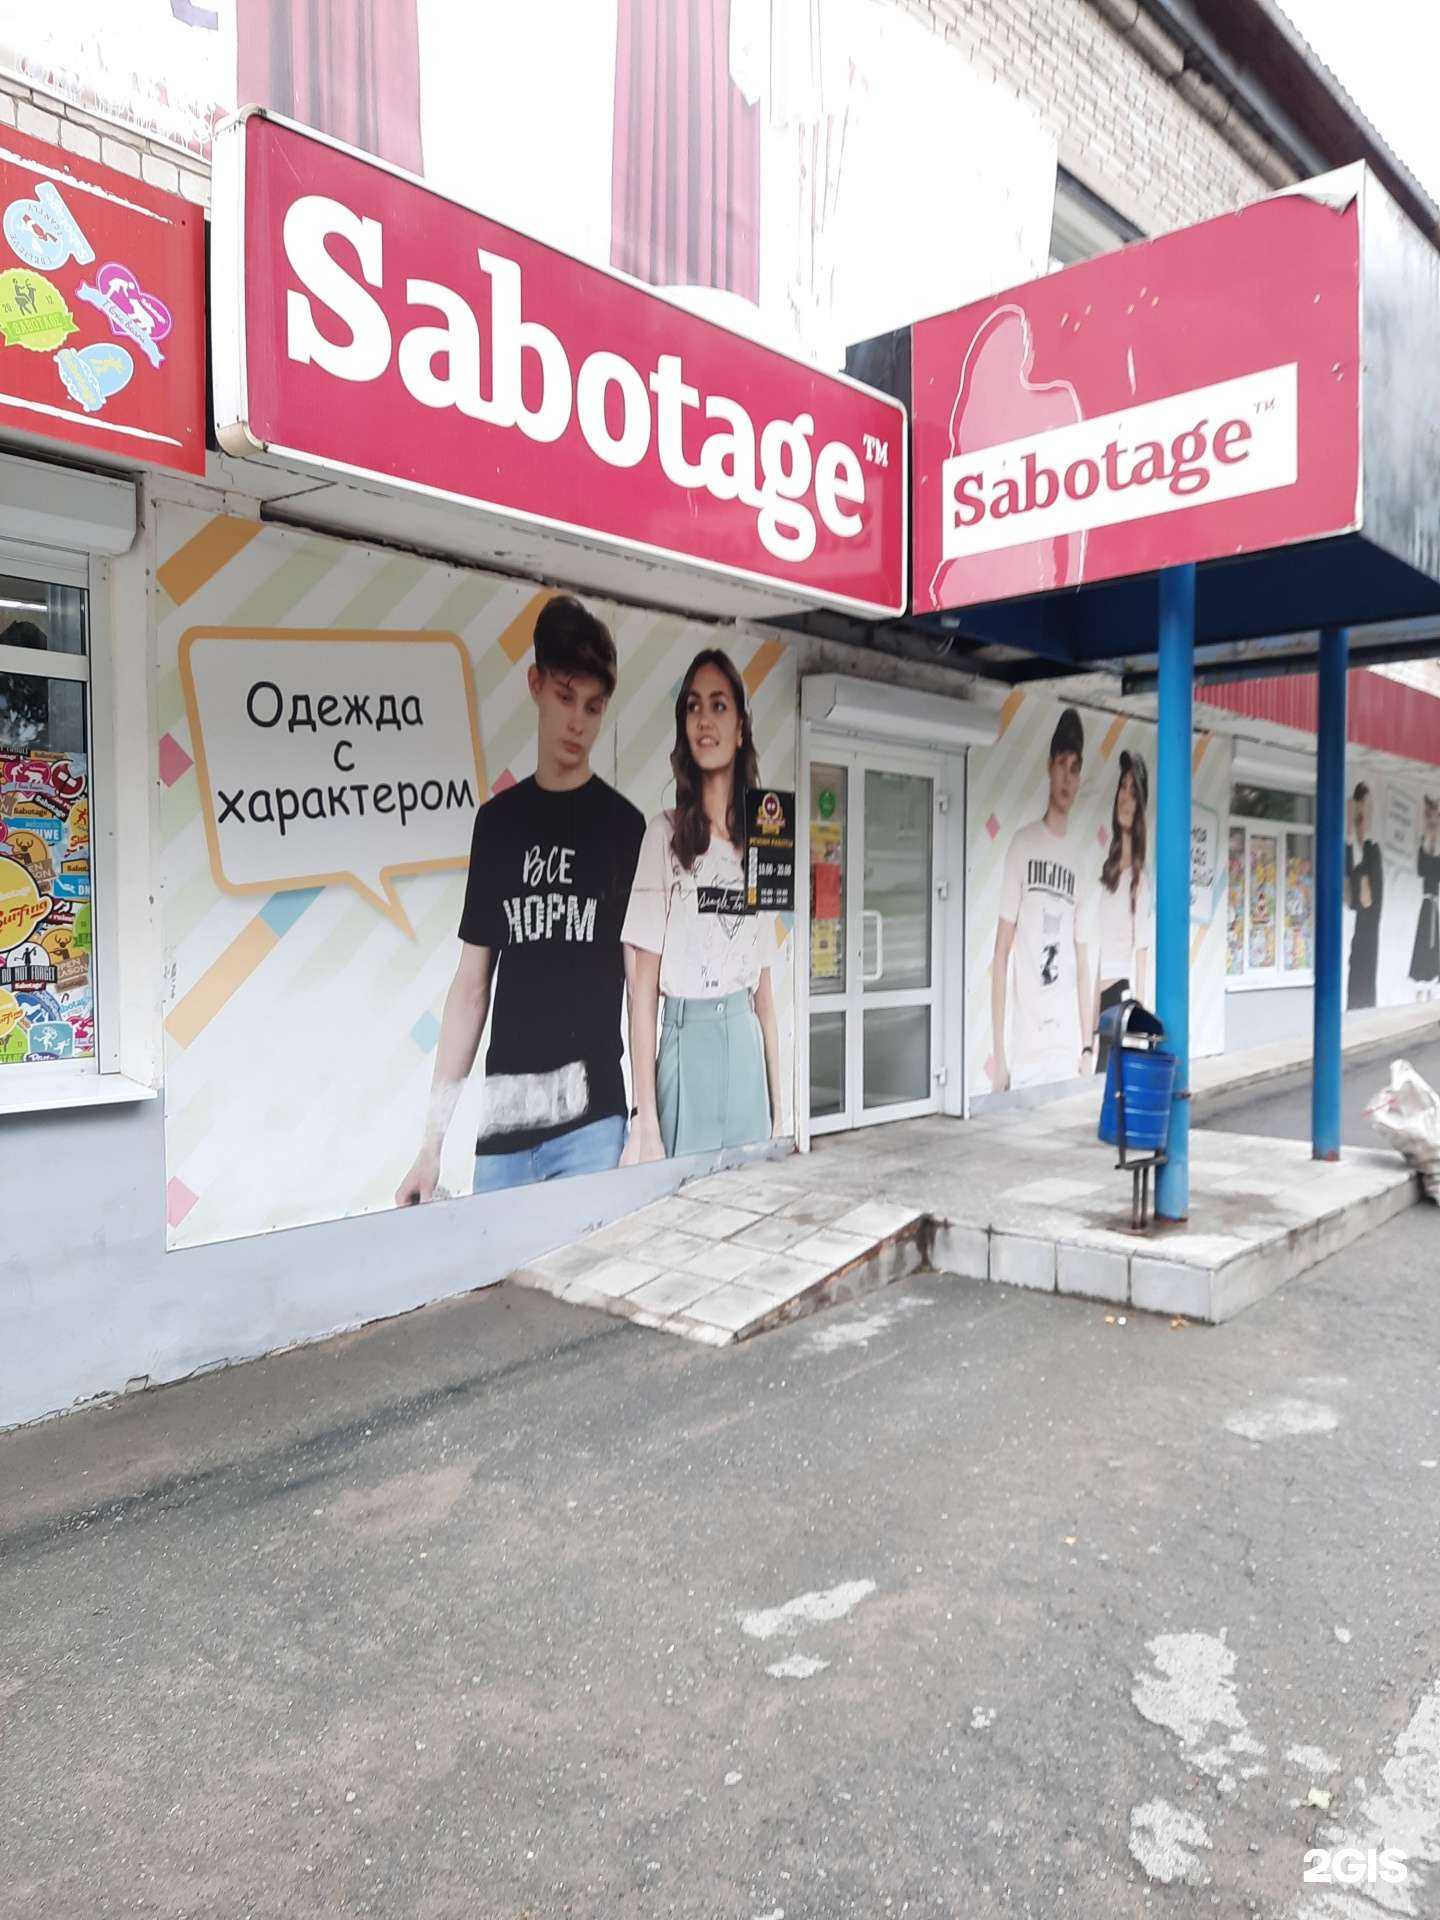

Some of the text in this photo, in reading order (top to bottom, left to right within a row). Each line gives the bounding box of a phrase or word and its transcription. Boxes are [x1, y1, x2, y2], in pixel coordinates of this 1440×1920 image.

[283, 194, 865, 563] Sabotage
[953, 418, 1253, 529] Sabotage
[246, 680, 424, 733] Одежда
[217, 778, 476, 836] характером
[523, 845, 576, 887] ВСЕ
[15, 966, 28, 981] NOT
